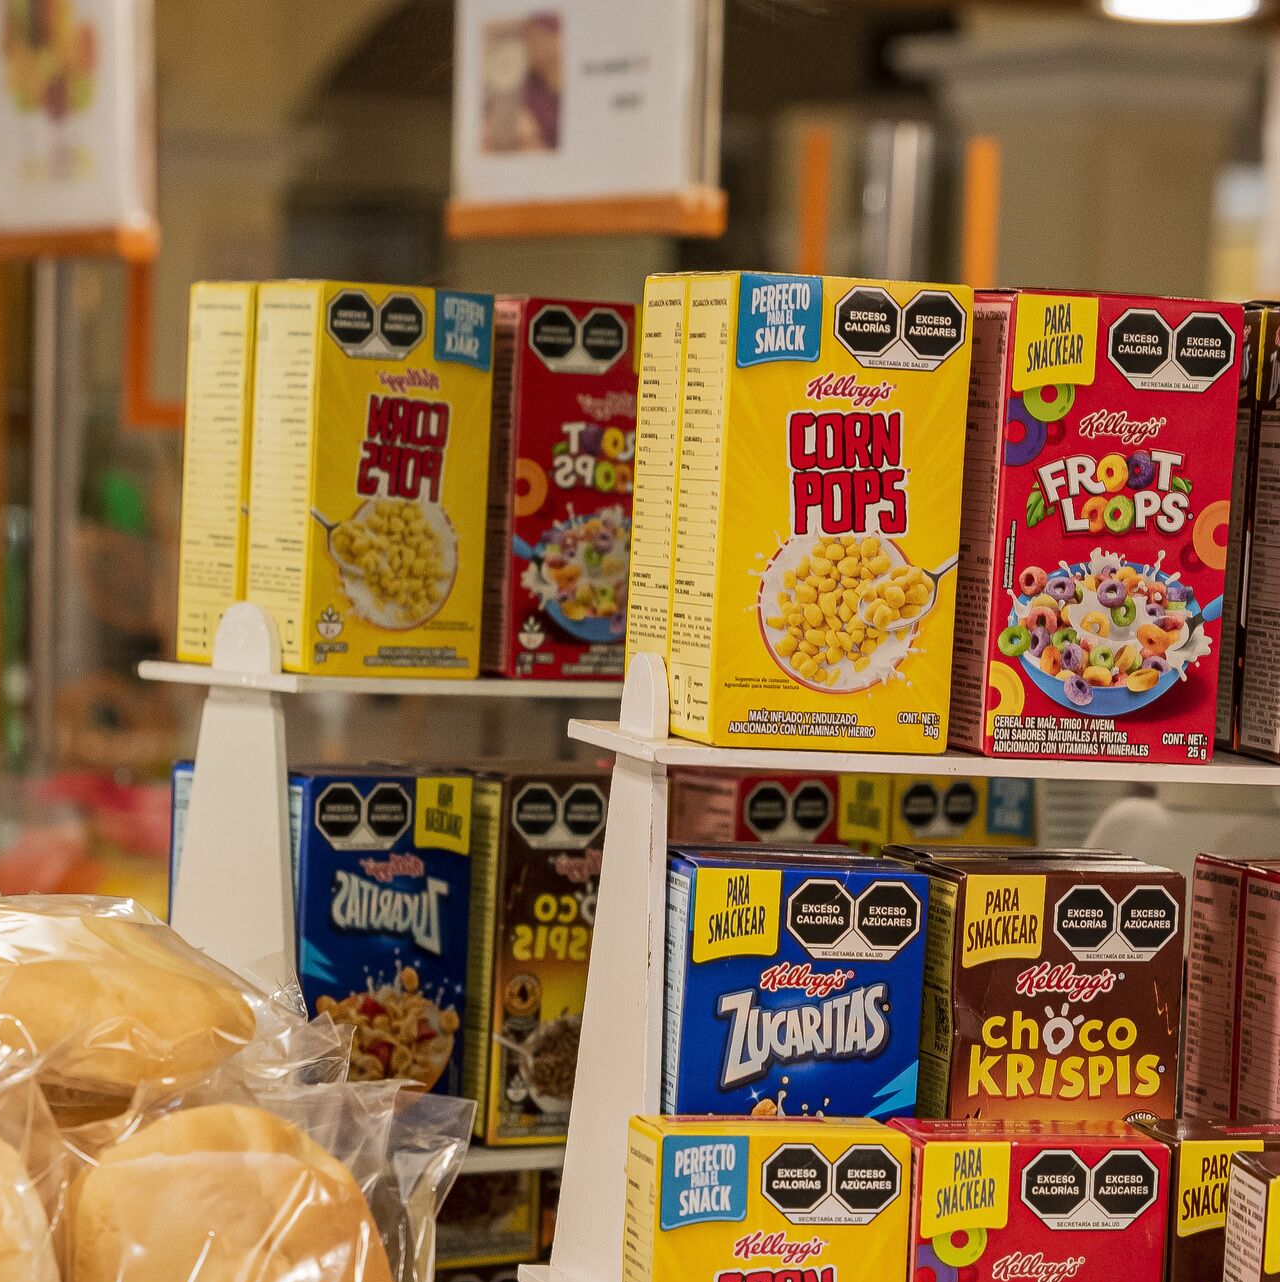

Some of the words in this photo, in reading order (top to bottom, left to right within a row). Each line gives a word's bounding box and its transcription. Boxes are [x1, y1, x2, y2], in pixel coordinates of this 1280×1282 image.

[752, 283, 810, 315] PERFECTO
[845, 321, 890, 334] CALORÍAS
[850, 311, 887, 322] EXCESO
[909, 325, 956, 338] AZÚCARES
[916, 315, 952, 326] EXCESO
[1044, 303, 1071, 336] PARA
[755, 325, 805, 353] SNACK
[1027, 334, 1084, 372] SNACKEAR
[1118, 344, 1162, 355] CALORÍAS
[1123, 334, 1159, 343] EXCESO
[1180, 347, 1226, 358] AZÚCARES
[1187, 337, 1222, 347] EXCESO
[806, 373, 891, 407] Kellogg's
[1079, 408, 1162, 443] Kellogg's
[789, 412, 903, 471] CORN
[1037, 449, 1183, 502] FROOT
[792, 470, 908, 535] POPS
[1059, 490, 1190, 536] LOOPS
[994, 716, 1023, 728] CEREAL
[1025, 717, 1036, 728] DE
[1037, 715, 1058, 730] MAÍZ,
[1060, 718, 1082, 730] TRIGO
[1084, 720, 1089, 730] Y
[1090, 720, 1115, 730] AVENA
[994, 730, 1010, 740] CON
[1012, 730, 1046, 741] SABORES
[1048, 730, 1090, 742] NATURALES
[1092, 732, 1098, 742] A
[1099, 732, 1127, 743] FRUTAS
[993, 741, 1040, 753] ADICIONADO
[1041, 742, 1057, 753] CON
[1058, 742, 1099, 754] VITAMINAS
[1100, 744, 1105, 755] Y
[1106, 744, 1149, 756] MINERALES
[727, 874, 749, 907] PARA
[985, 887, 1019, 915] PARA
[797, 915, 844, 925] CALORÍAS
[802, 904, 840, 914] EXCESO
[862, 916, 912, 927] AZÚCARES
[869, 907, 906, 916] EXCESO
[708, 906, 765, 944] SNACKEAR
[967, 914, 1038, 952] SNACKEAR
[760, 962, 847, 997] Kellogg's
[1016, 961, 1116, 1001] Kellogg's
[716, 983, 889, 1091] ZUCARITAS
[967, 1045, 1160, 1099] KRISPIS
[674, 1144, 735, 1178] PERFECTO
[778, 1169, 817, 1179] EXCESO
[847, 1169, 886, 1179] EXCESO
[953, 1148, 982, 1182] PARA
[772, 1179, 821, 1190] CALORÍAS
[840, 1180, 891, 1190] AZÚCARES
[936, 1178, 995, 1219] SNACKEAR
[679, 1185, 731, 1217] SNACK
[734, 1231, 822, 1264] Kellogg's
